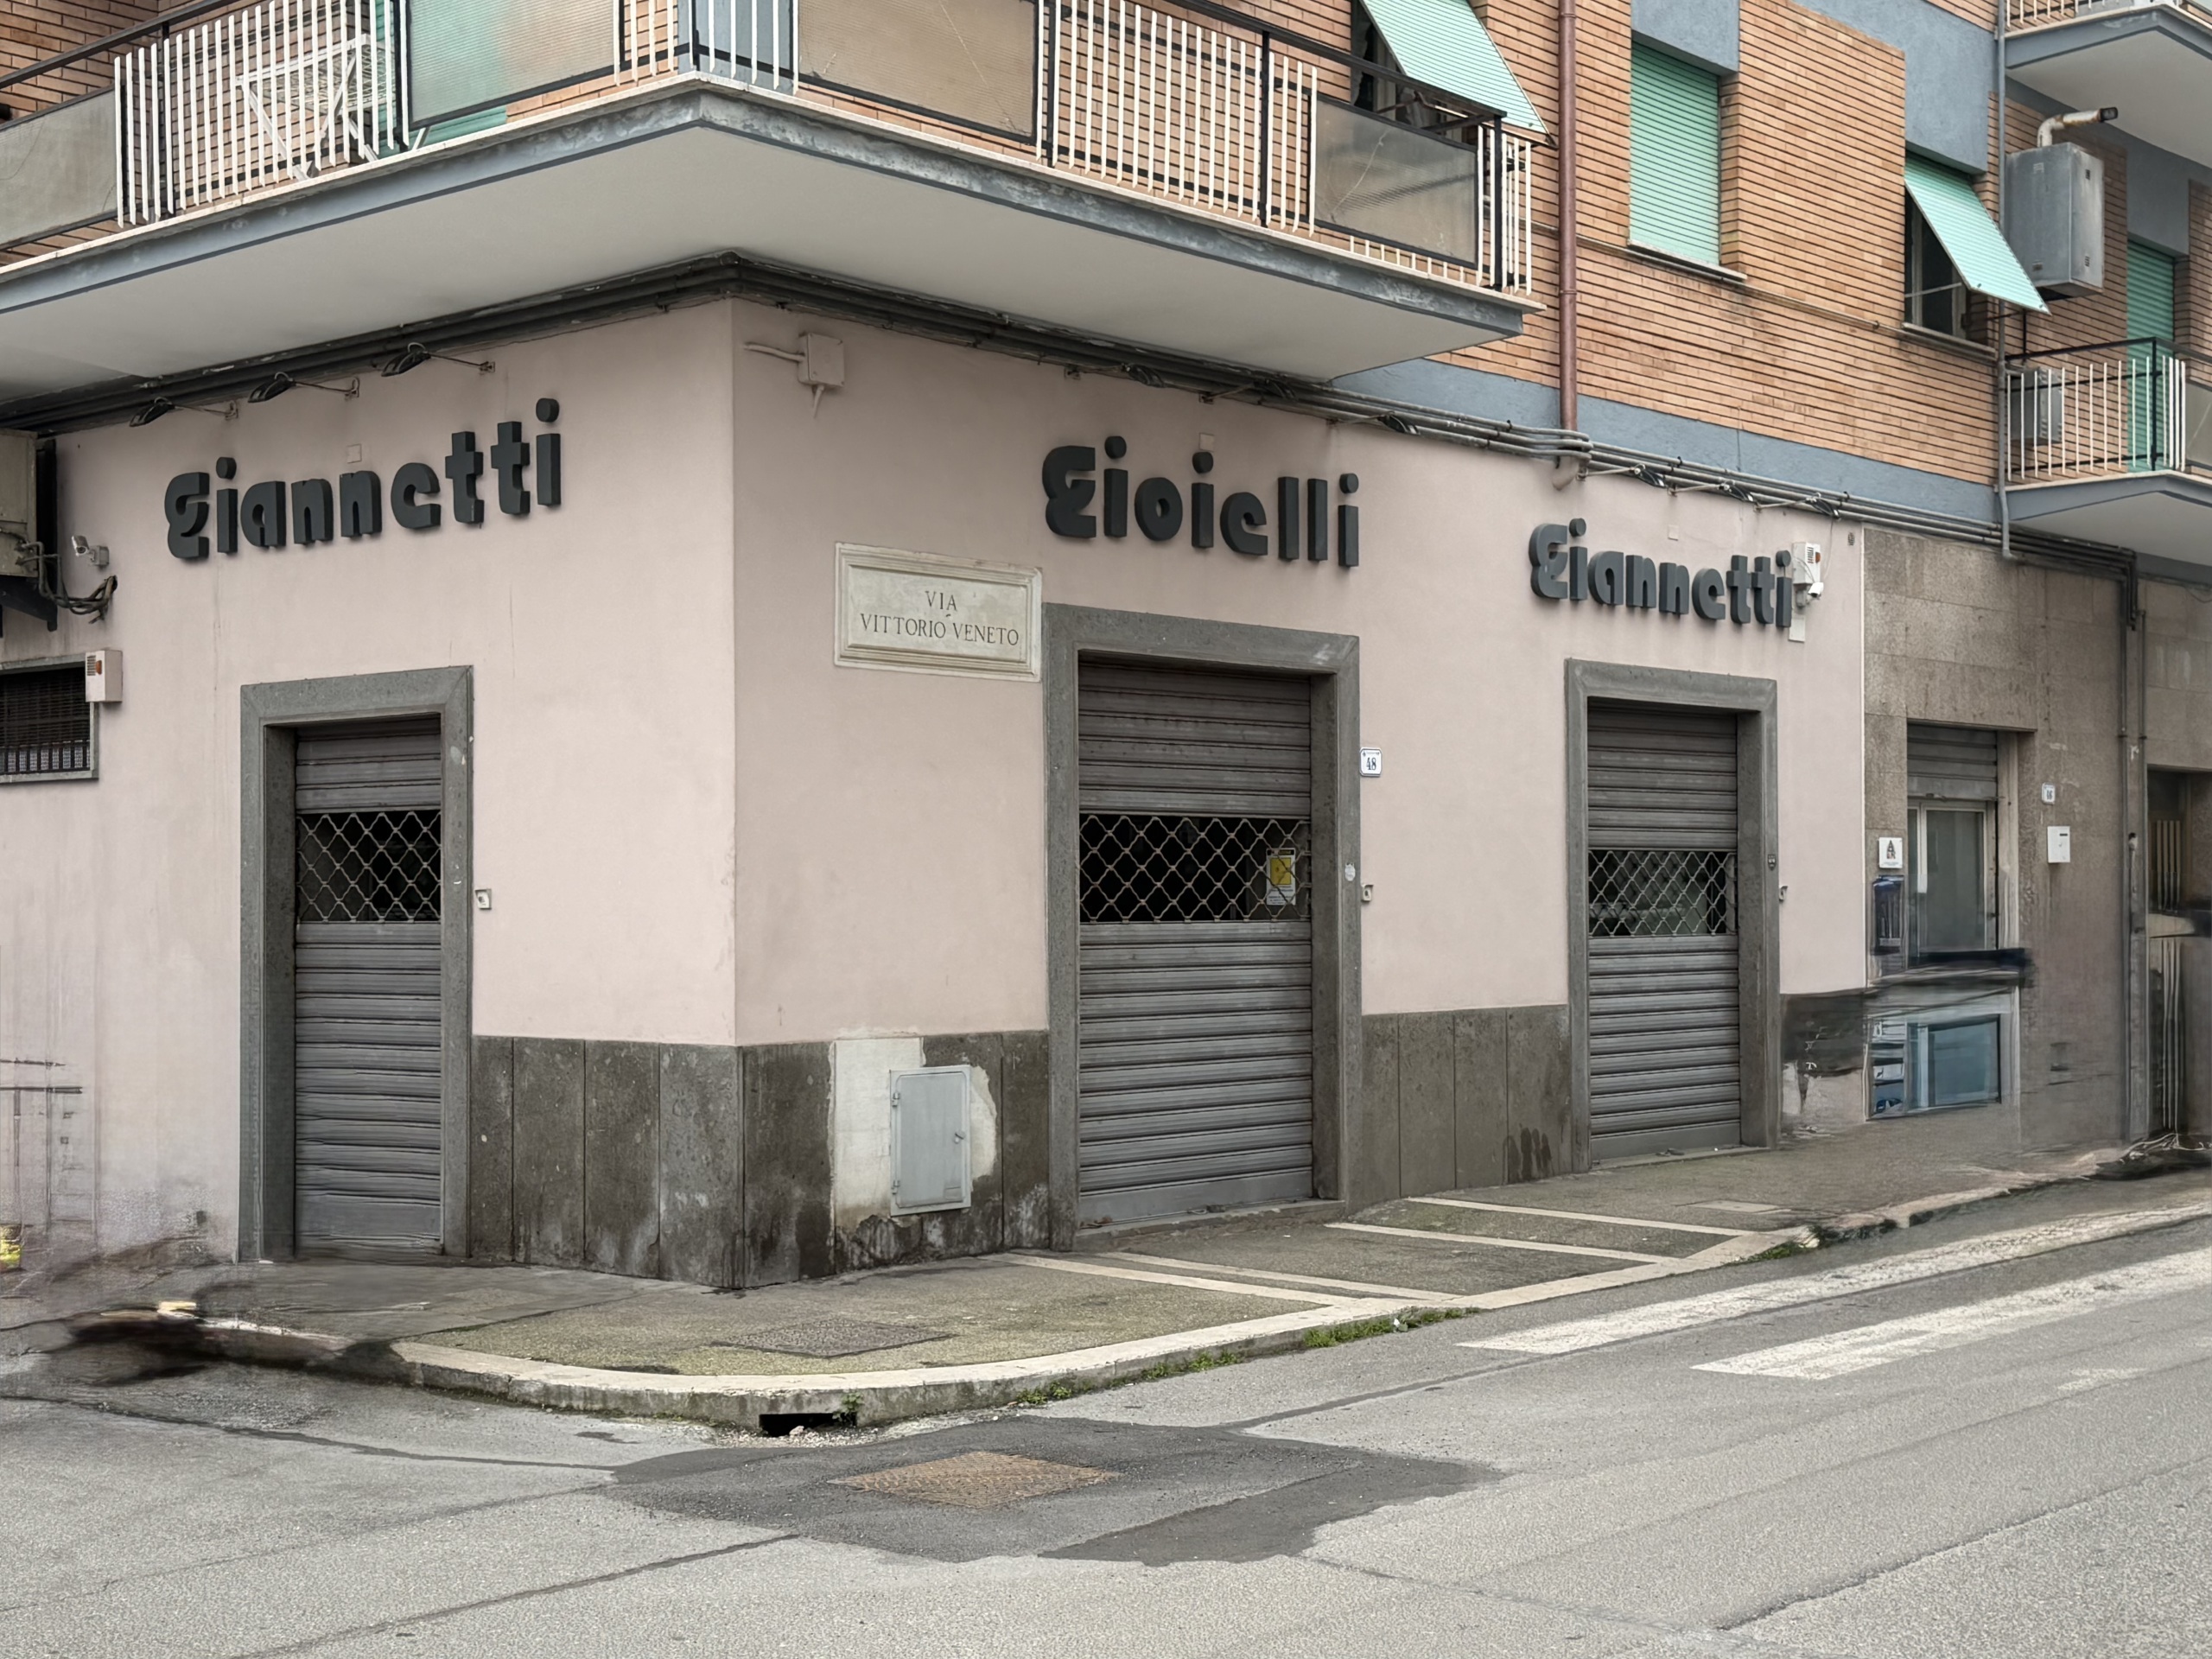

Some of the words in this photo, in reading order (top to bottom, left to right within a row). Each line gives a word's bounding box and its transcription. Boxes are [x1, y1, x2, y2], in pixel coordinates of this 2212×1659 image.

[164, 397, 561, 559] Giannetti
[1042, 435, 1359, 567] Gioielli
[925, 590, 957, 611] VIA
[1529, 518, 1792, 628] Giannetti
[861, 613, 946, 639] VITTORIO
[952, 622, 1019, 645] VENETO
[1365, 757, 1376, 771] 48
